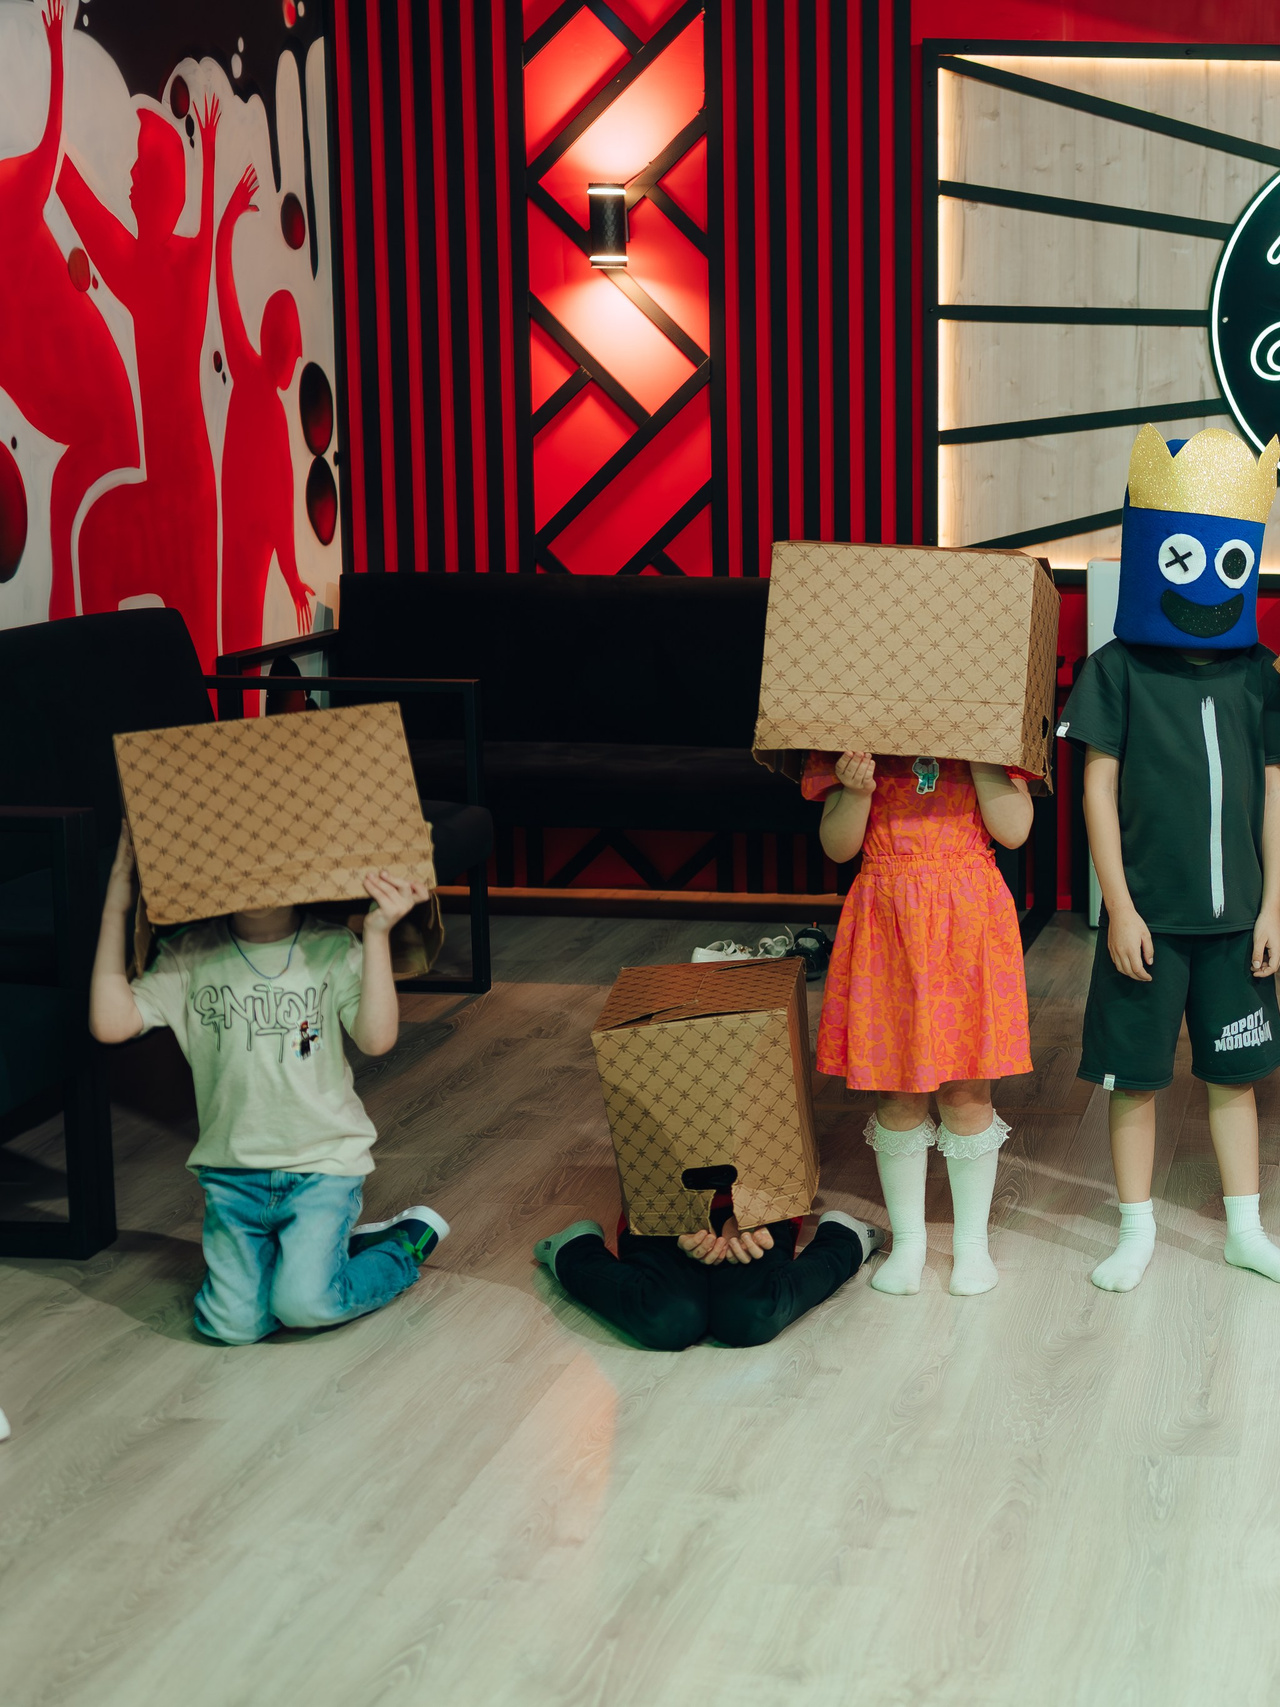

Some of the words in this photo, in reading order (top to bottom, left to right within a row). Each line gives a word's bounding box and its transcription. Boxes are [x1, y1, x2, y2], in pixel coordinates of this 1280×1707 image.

[192, 983, 327, 1050] ENJOY
[1221, 1006, 1264, 1039] ДОРОГУ
[1213, 1020, 1273, 1053] МОЛОДЫМ
